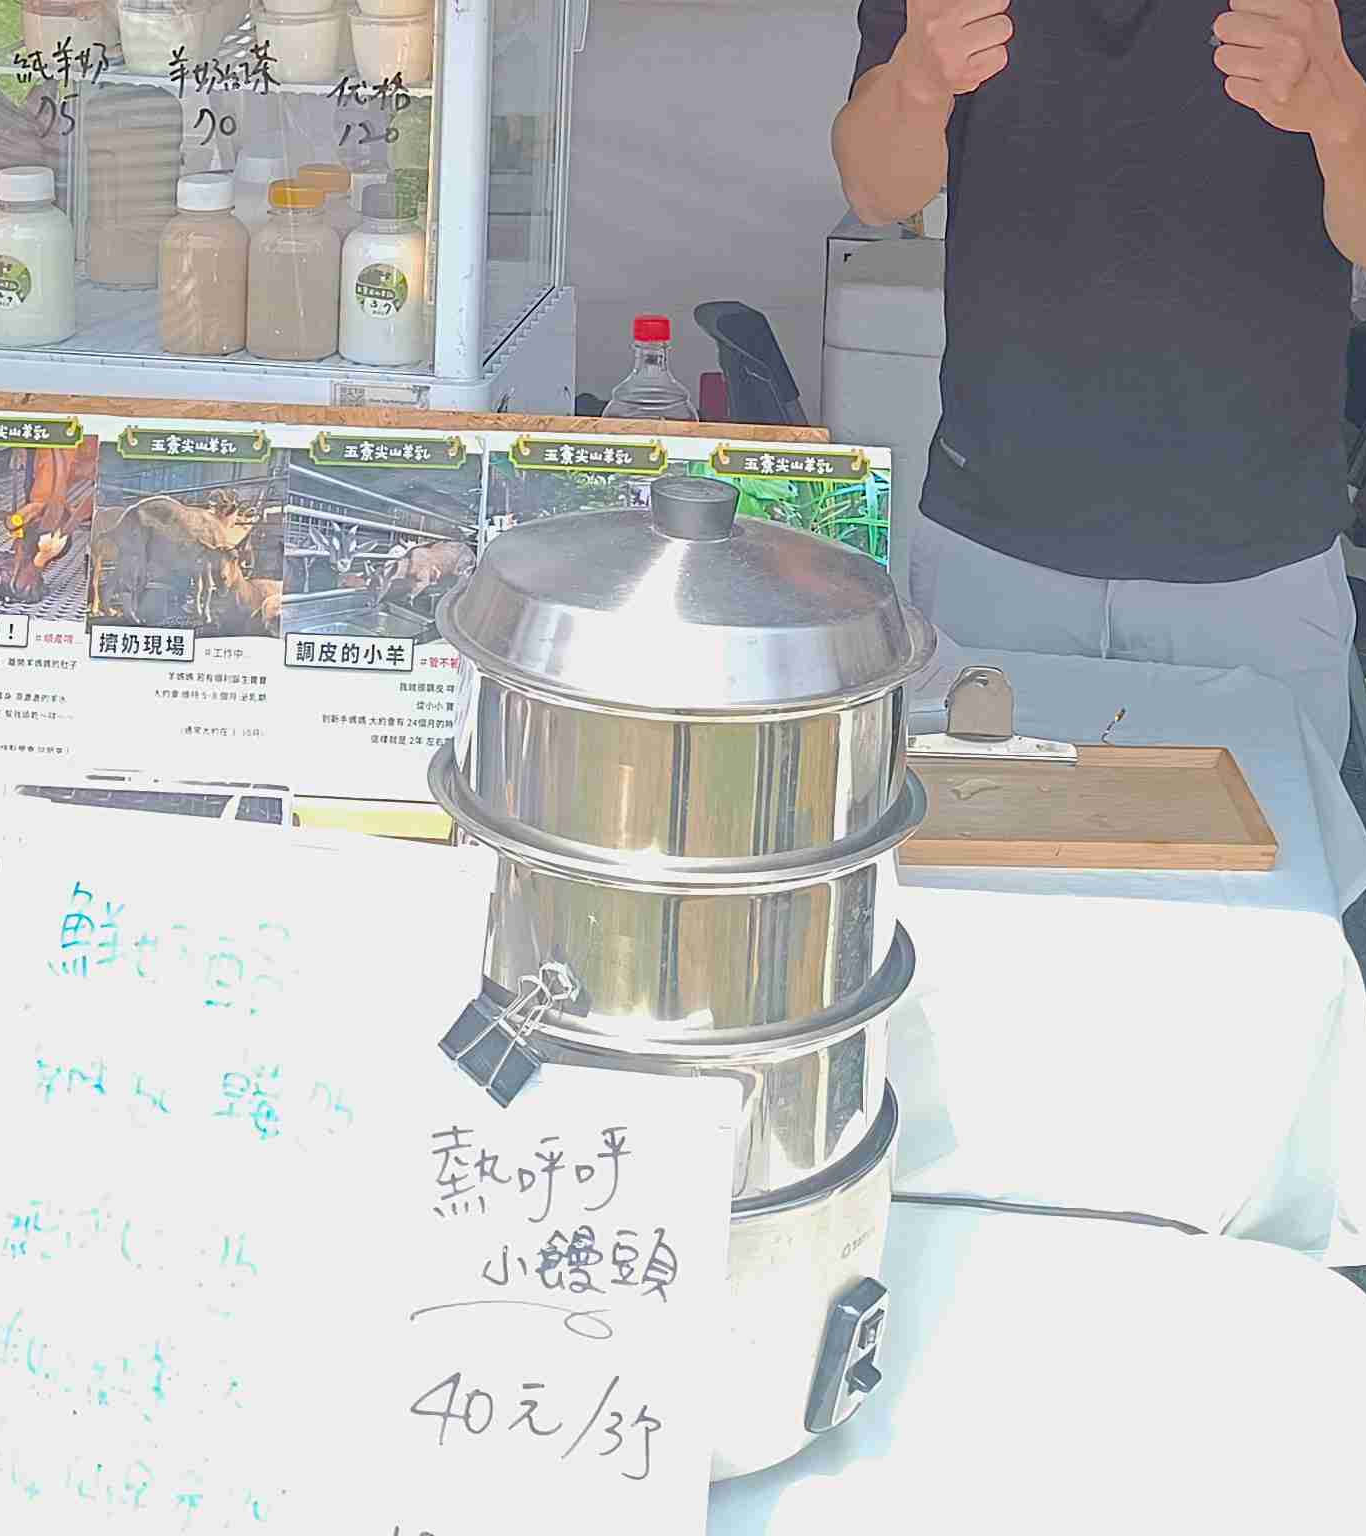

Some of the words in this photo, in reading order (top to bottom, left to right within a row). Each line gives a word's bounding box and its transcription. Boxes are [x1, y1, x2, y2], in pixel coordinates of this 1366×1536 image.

[13, 36, 110, 85] 純羊奶
[36, 93, 79, 139] 75
[193, 107, 237, 146] 70
[338, 123, 400, 147] 120
[99, 631, 186, 657] 擠奶現場
[295, 640, 406, 666] 調皮的小羊
[430, 1124, 635, 1224] 熱呼呼
[481, 1224, 679, 1304] 小饅頭
